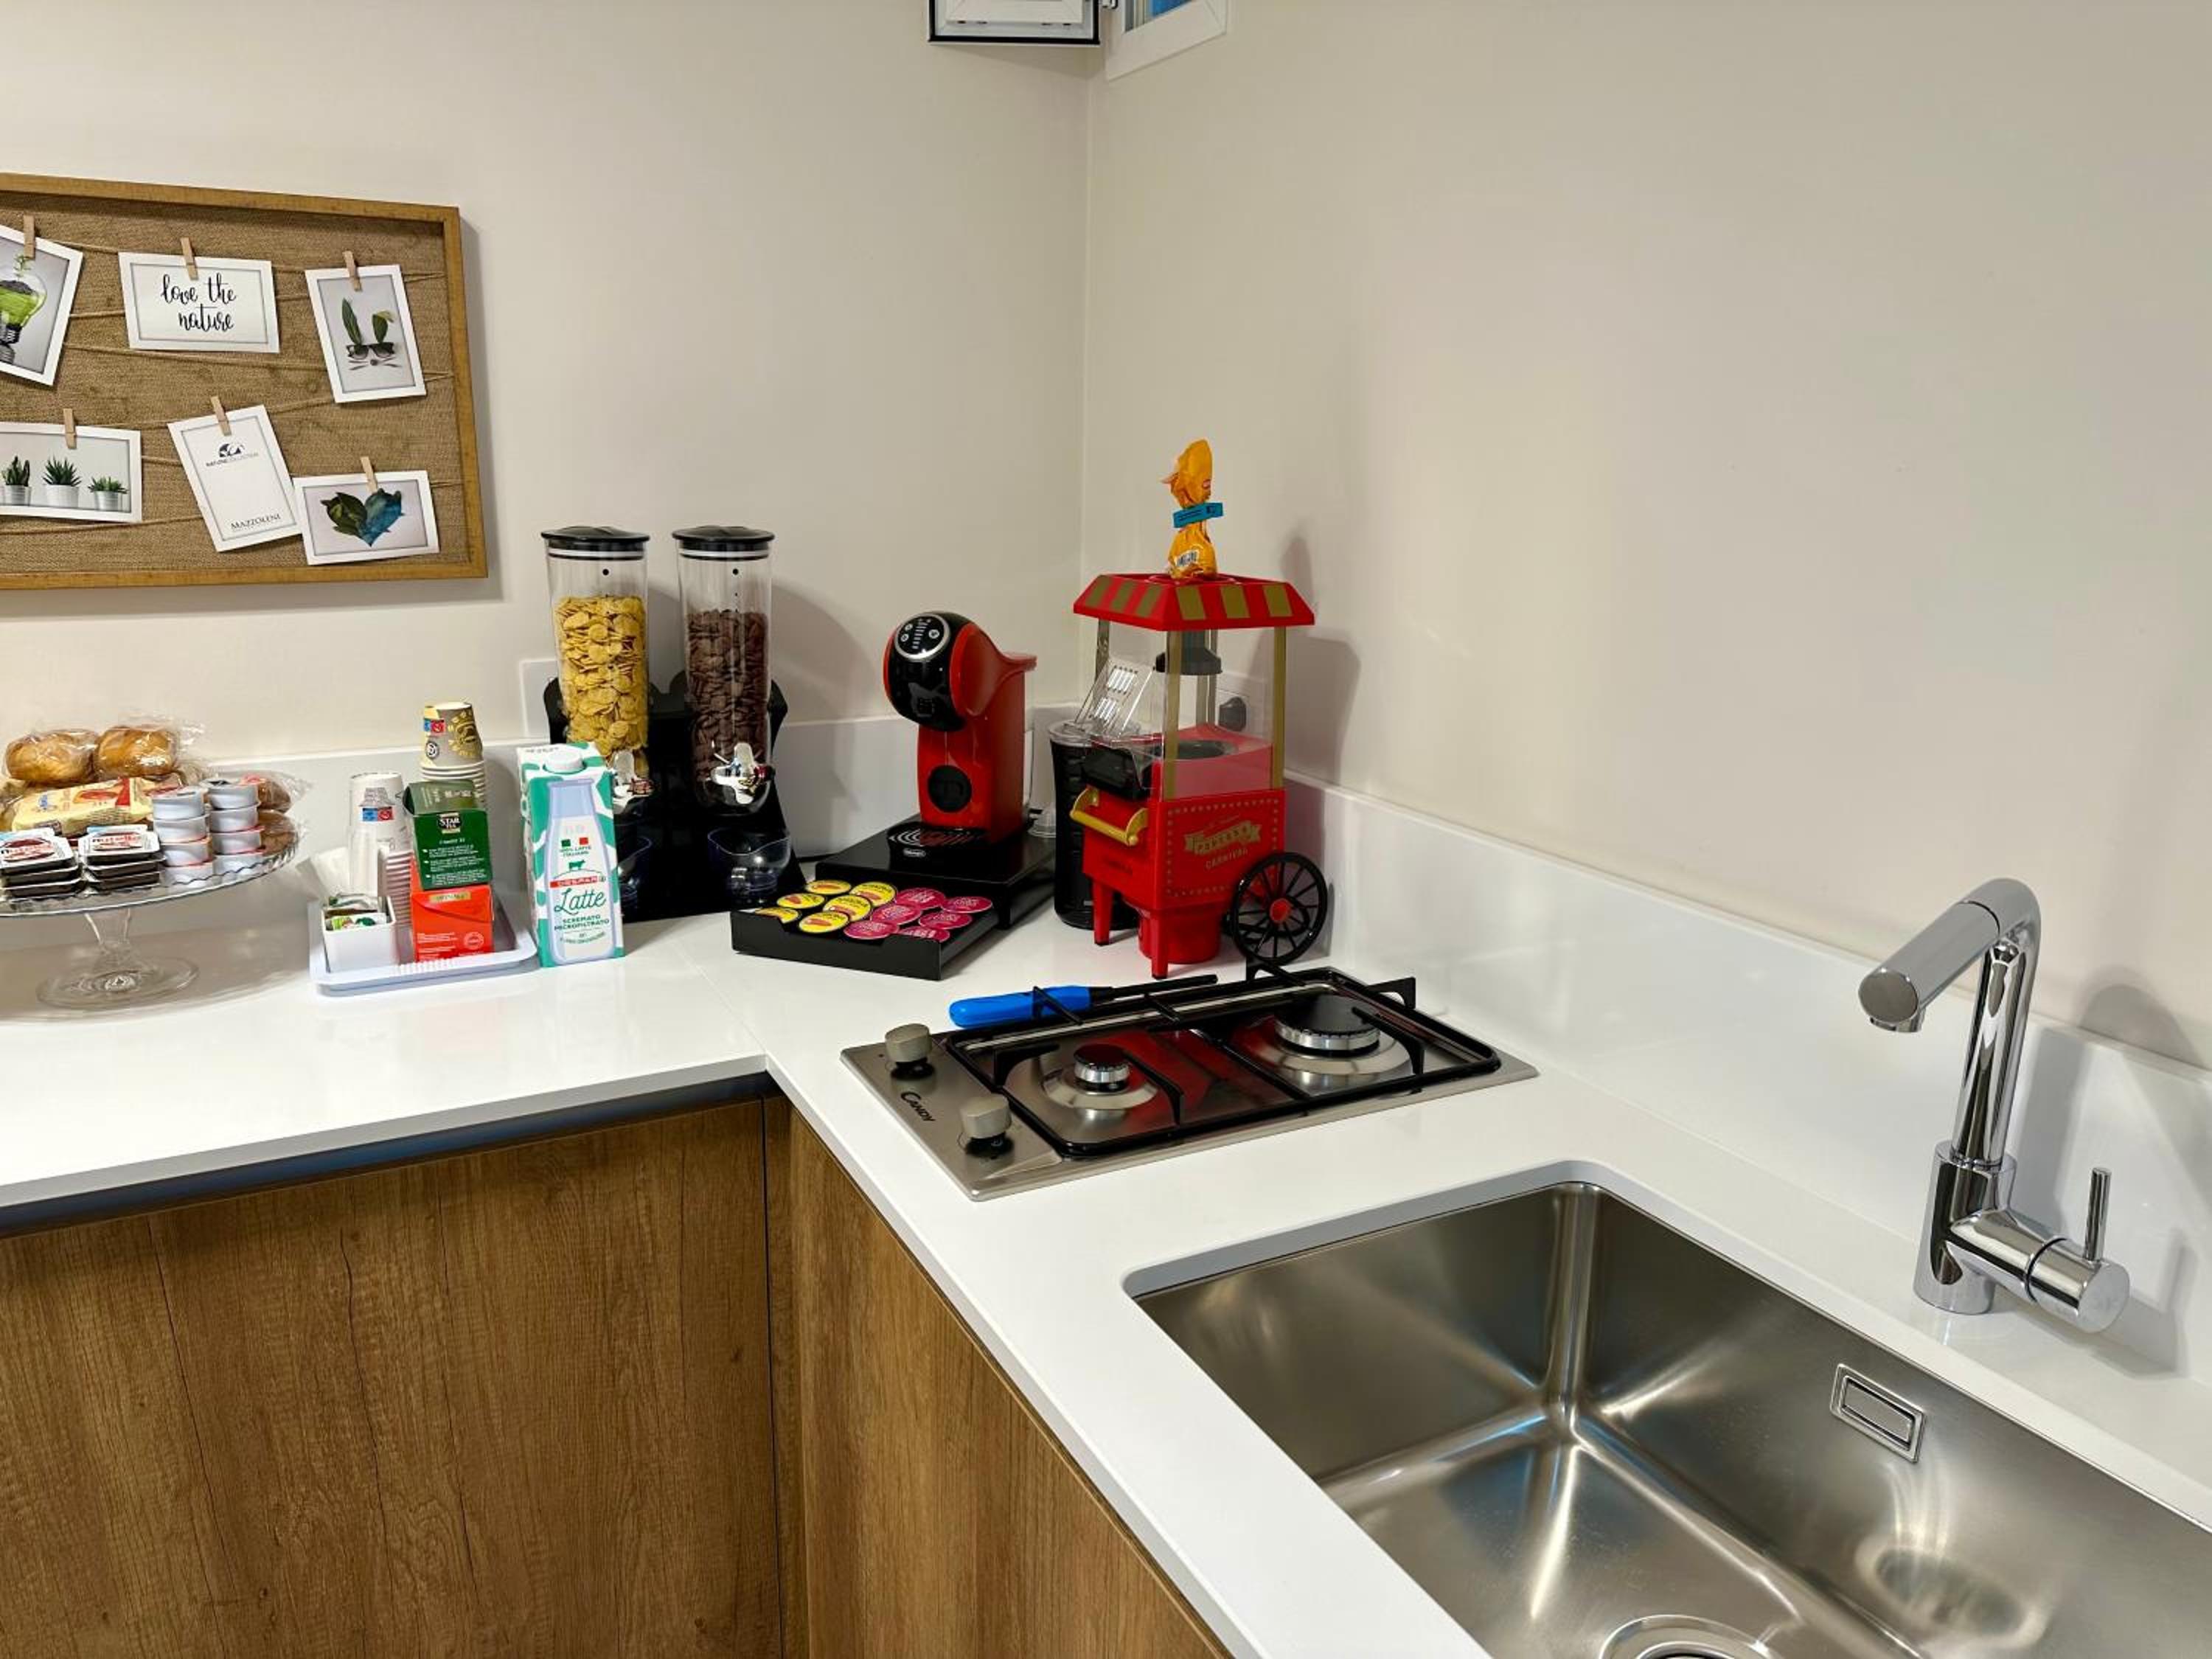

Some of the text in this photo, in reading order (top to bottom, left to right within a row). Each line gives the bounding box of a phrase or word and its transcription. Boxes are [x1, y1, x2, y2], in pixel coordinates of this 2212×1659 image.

[160, 272, 237, 305] love the
[178, 303, 234, 332] nature
[554, 888, 607, 916] Latte
